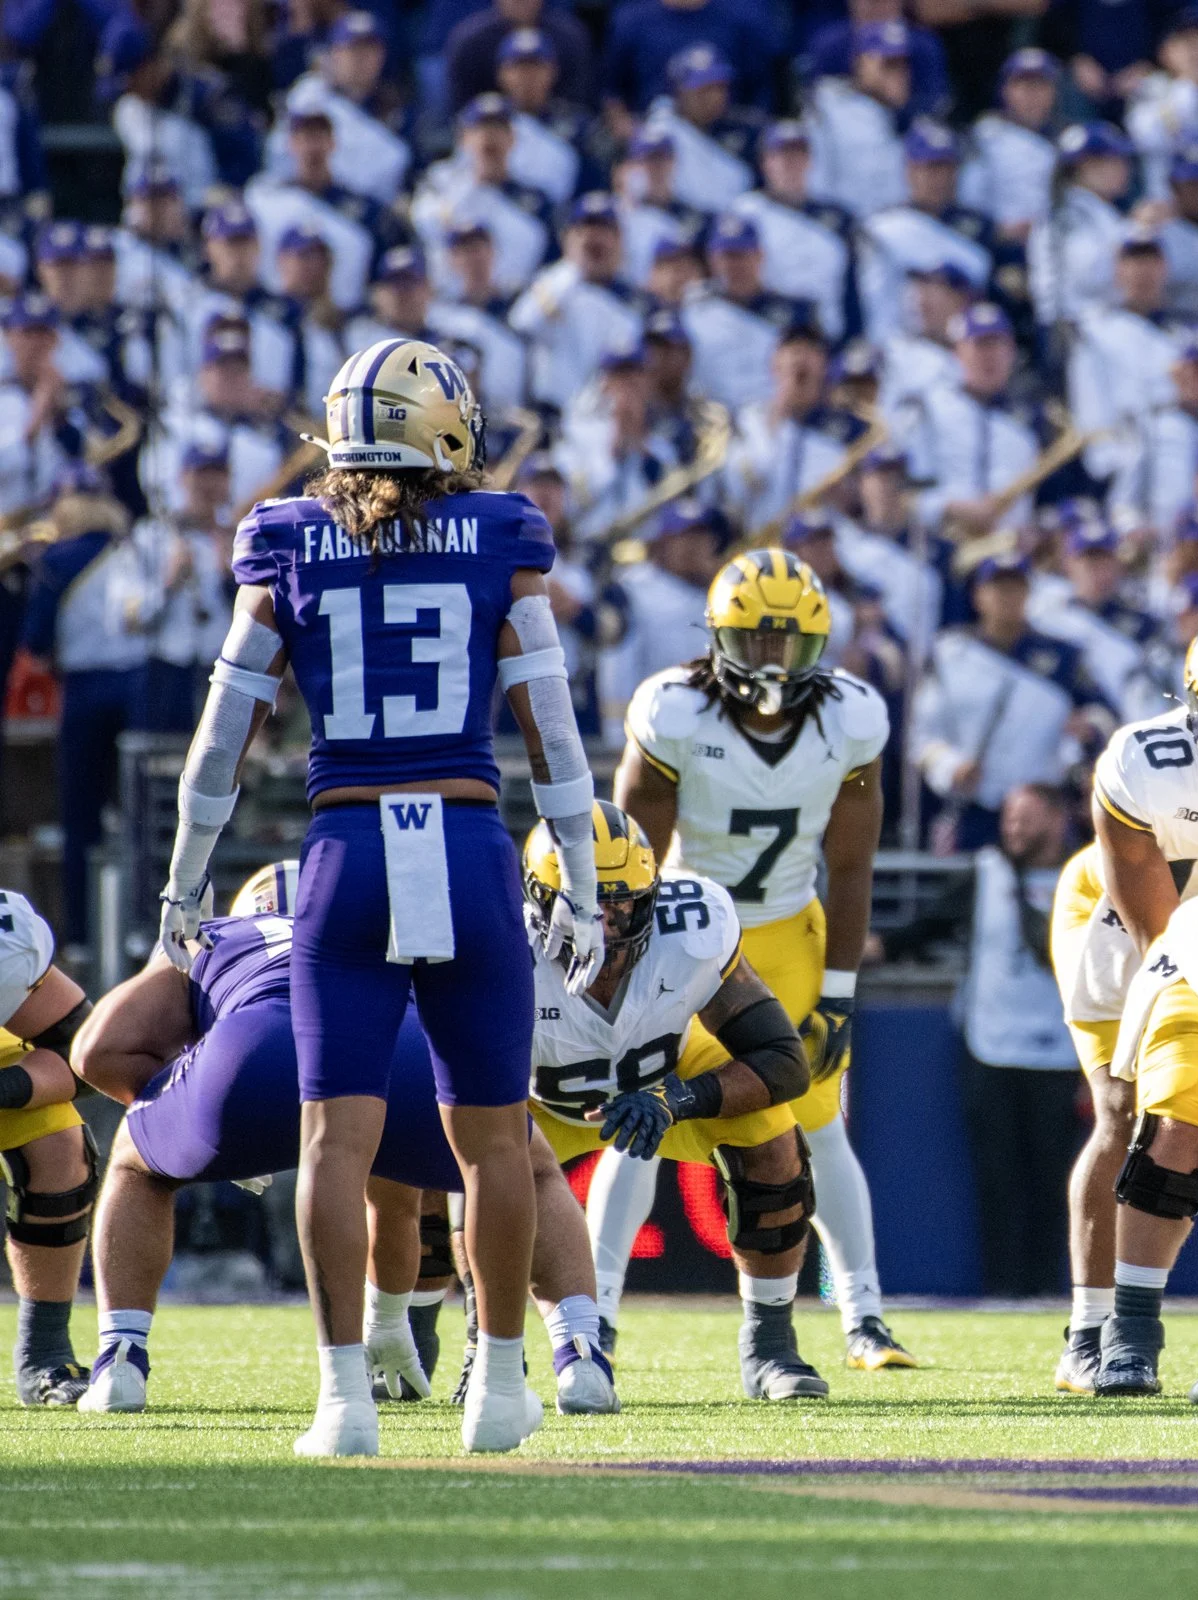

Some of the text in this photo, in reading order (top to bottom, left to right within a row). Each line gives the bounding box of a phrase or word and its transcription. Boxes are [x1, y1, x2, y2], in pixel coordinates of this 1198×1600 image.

[424, 362, 471, 400] W
[318, 583, 472, 740] 13
[1134, 726, 1194, 769] 10
[389, 803, 432, 830] W
[727, 807, 801, 904] 7
[603, 882, 618, 893] M
[656, 878, 710, 936] 58
[1148, 953, 1178, 978] M
